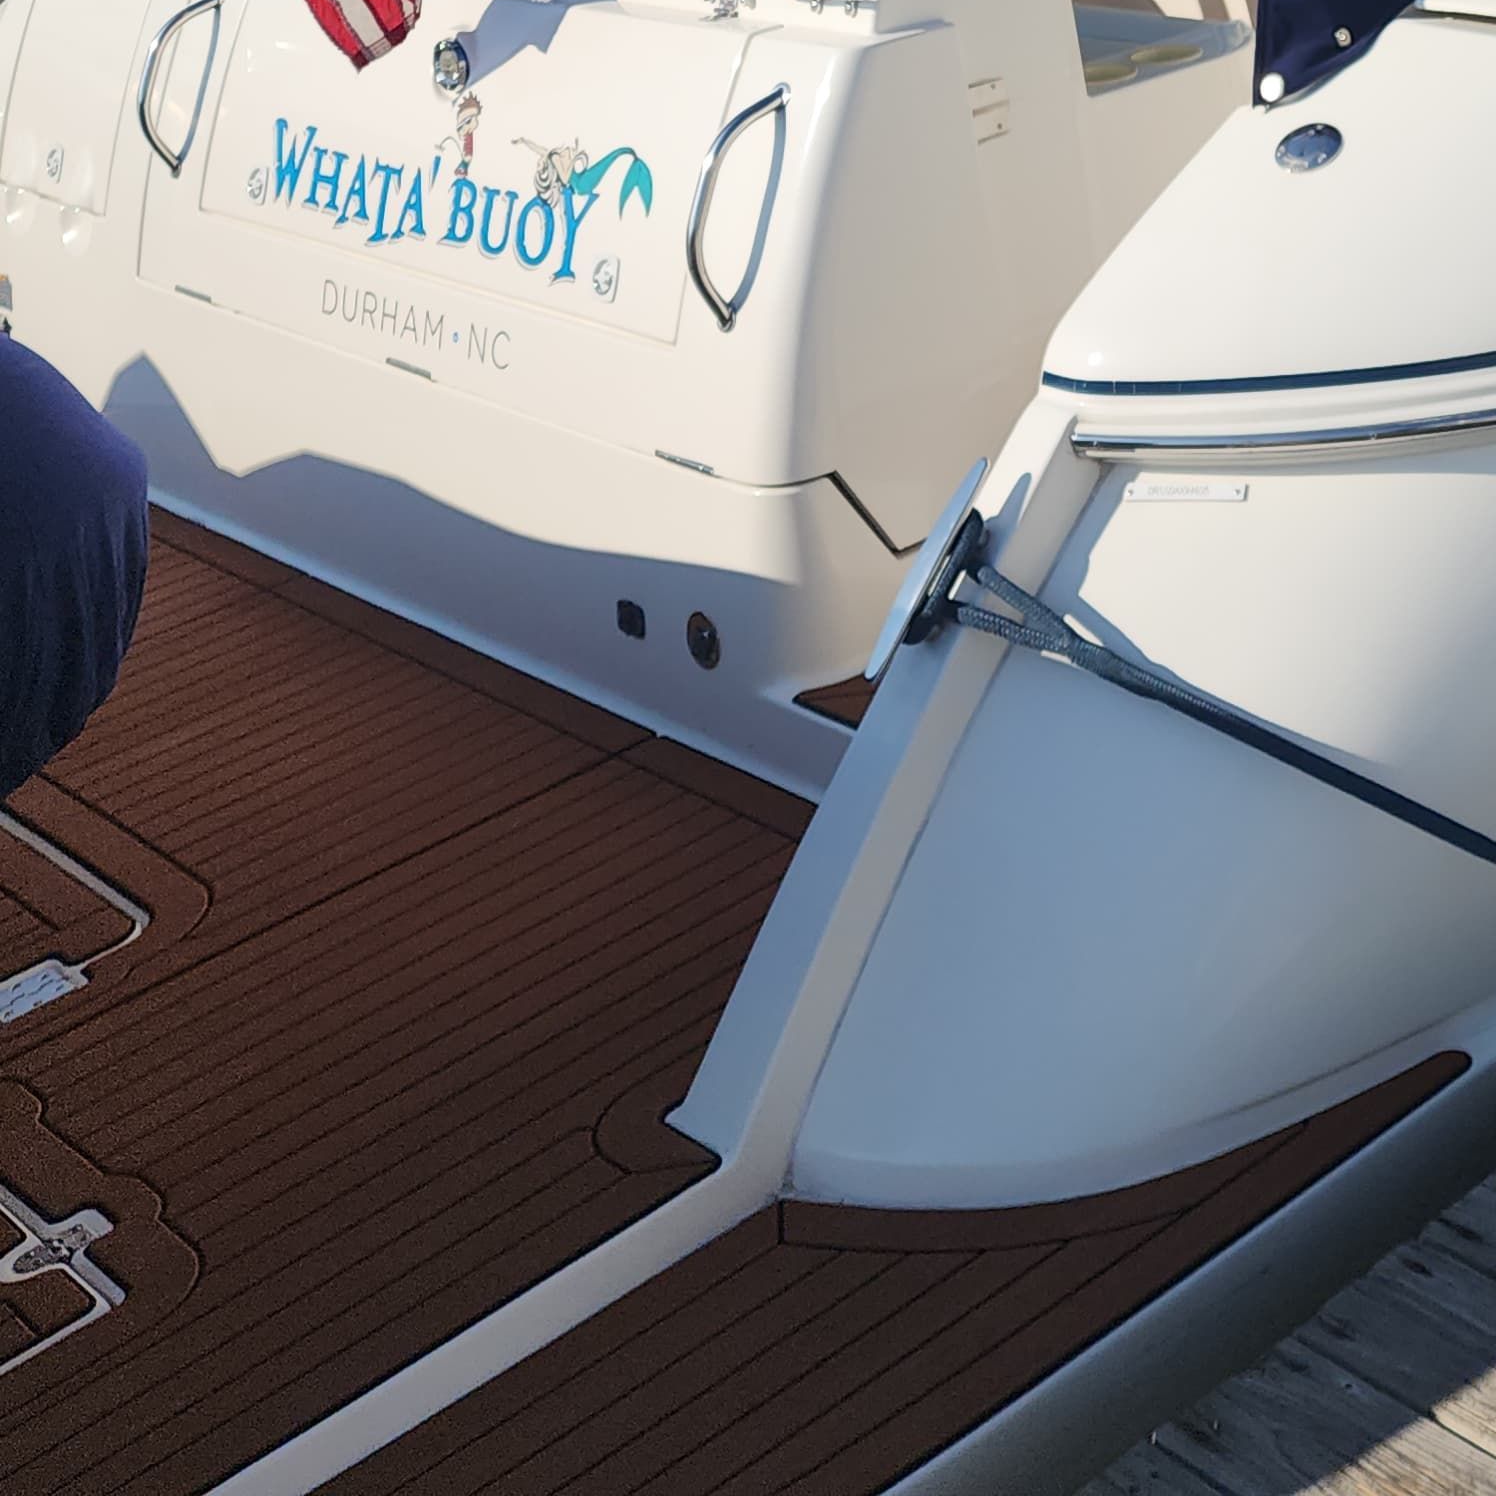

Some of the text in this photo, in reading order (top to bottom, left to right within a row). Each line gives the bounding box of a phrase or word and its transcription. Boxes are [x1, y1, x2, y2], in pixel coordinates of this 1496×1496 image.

[437, 177, 601, 286] BUOY
[321, 278, 511, 371] DURHAM NC
